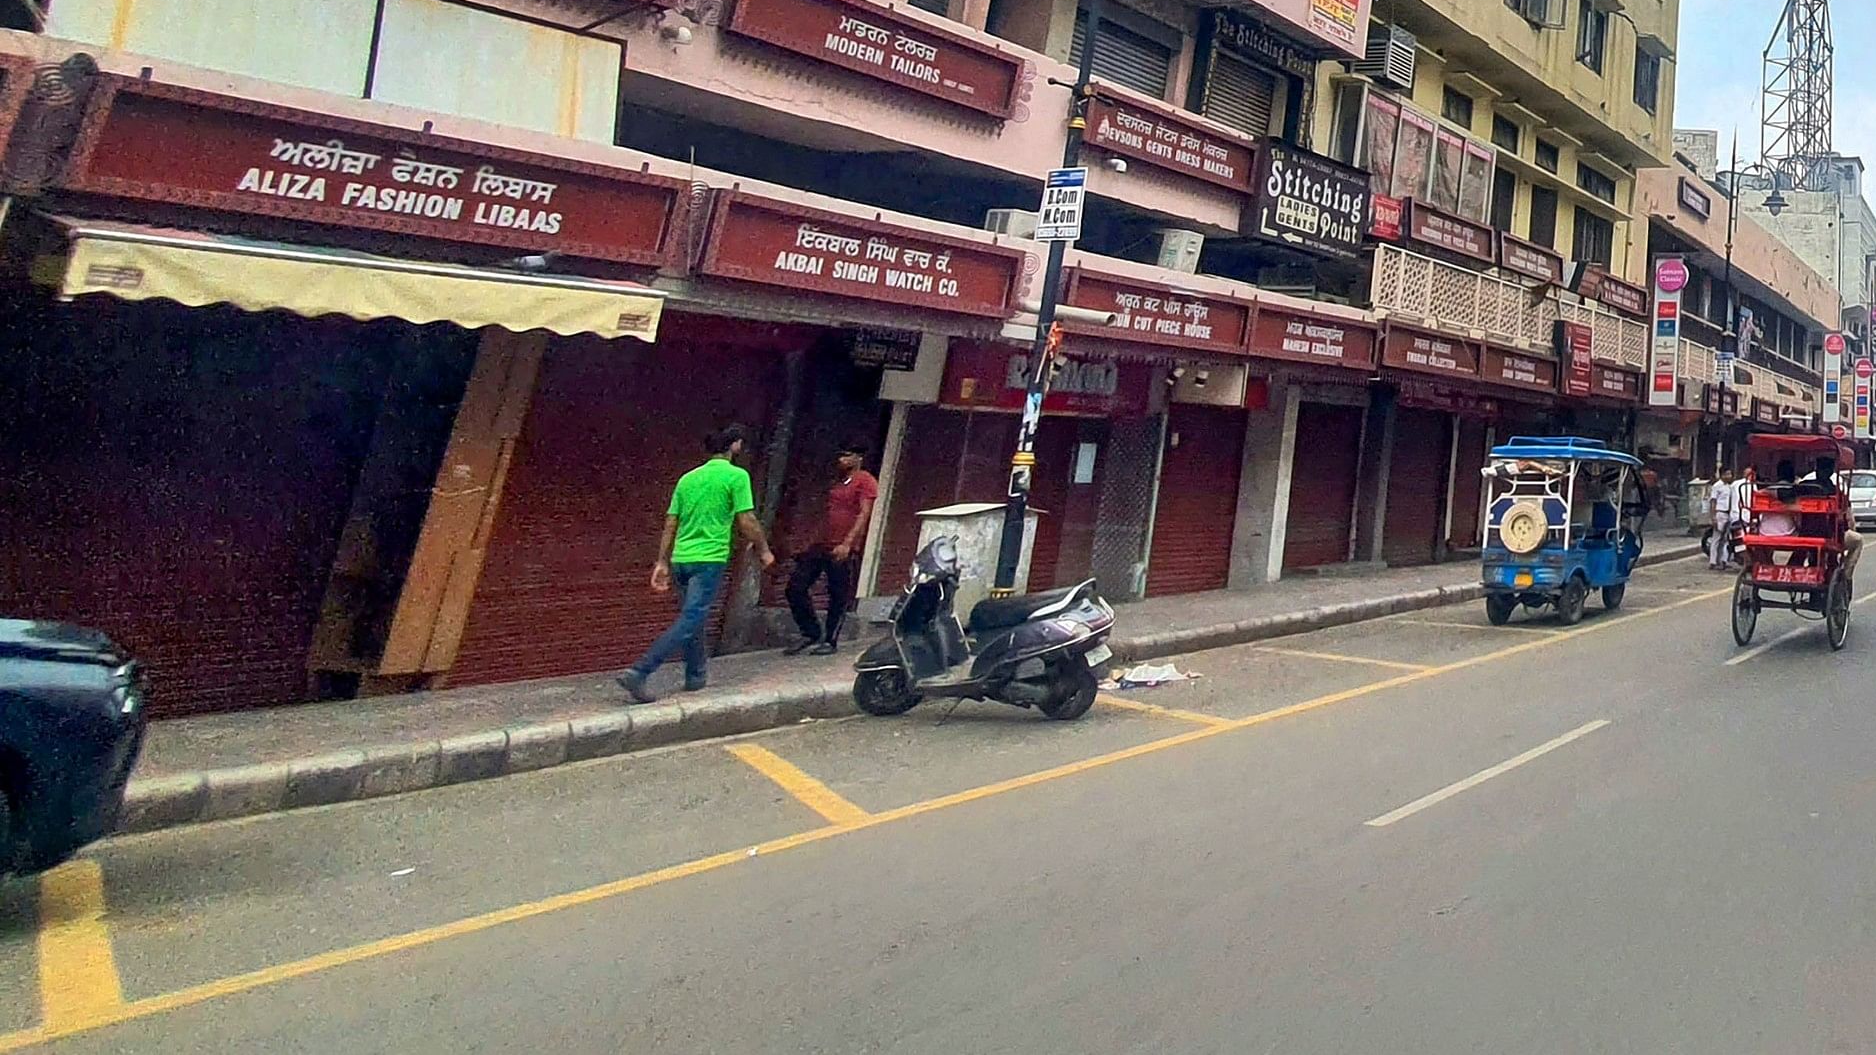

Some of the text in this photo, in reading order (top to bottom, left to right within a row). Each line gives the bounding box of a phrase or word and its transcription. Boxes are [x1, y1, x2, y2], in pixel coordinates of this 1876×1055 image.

[825, 33, 884, 66] MODERN
[890, 55, 941, 84] TAILORS
[1146, 140, 1172, 159] GENTS
[1175, 150, 1201, 168] DRESS
[1203, 159, 1234, 179] MAKERS
[237, 168, 563, 234] ALIZA FASHION LIBAAS
[1267, 160, 1363, 224] Stitching
[1281, 197, 1318, 217] LADIES
[1279, 212, 1316, 232] GENTS
[1320, 212, 1357, 244] Point
[832, 261, 879, 284] SINGH
[885, 269, 932, 293] WATCH
[938, 279, 959, 296] CO.
[1134, 316, 1153, 331] CUT
[1156, 319, 1182, 335] PIECE
[1184, 323, 1212, 339] HOUSE
